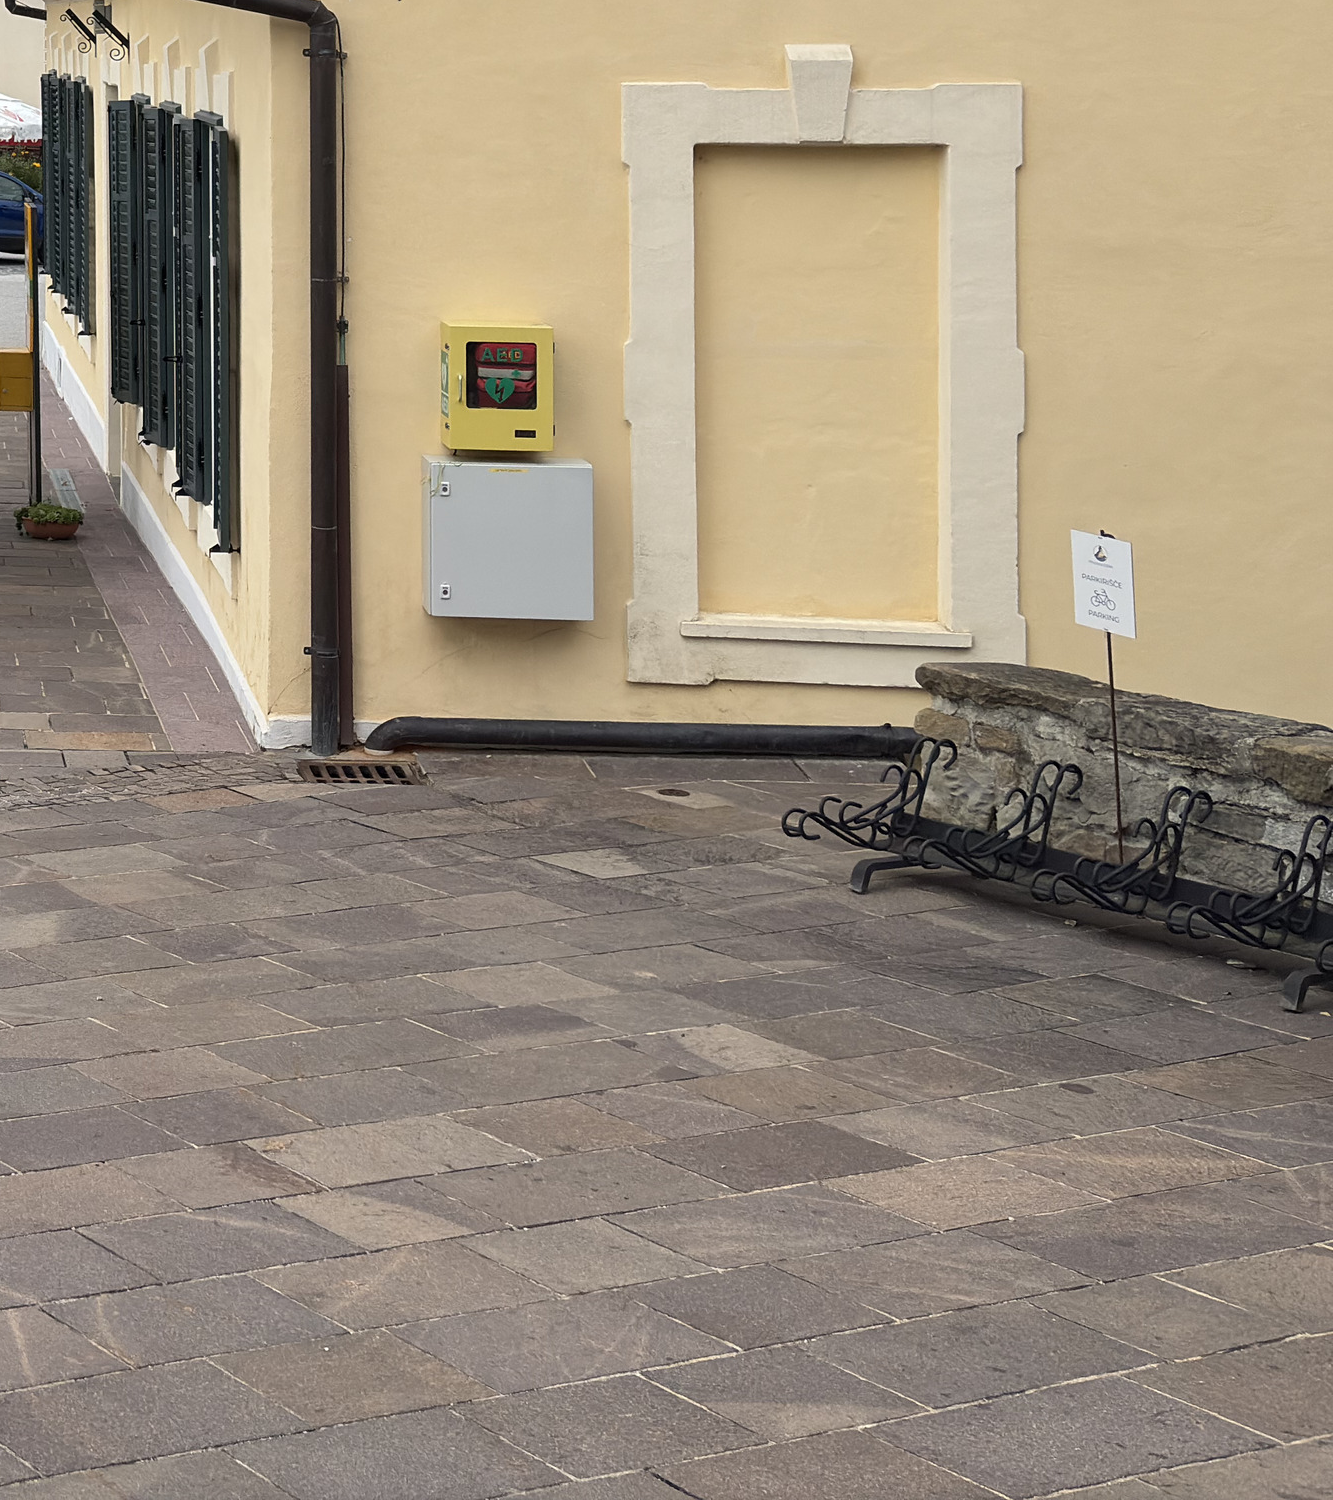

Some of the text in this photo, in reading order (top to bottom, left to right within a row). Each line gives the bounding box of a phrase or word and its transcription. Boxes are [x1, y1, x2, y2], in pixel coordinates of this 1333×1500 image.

[481, 348, 524, 362] AED
[1081, 573, 1123, 589] PARKIRIŠČE
[1088, 609, 1120, 624] PARKING
